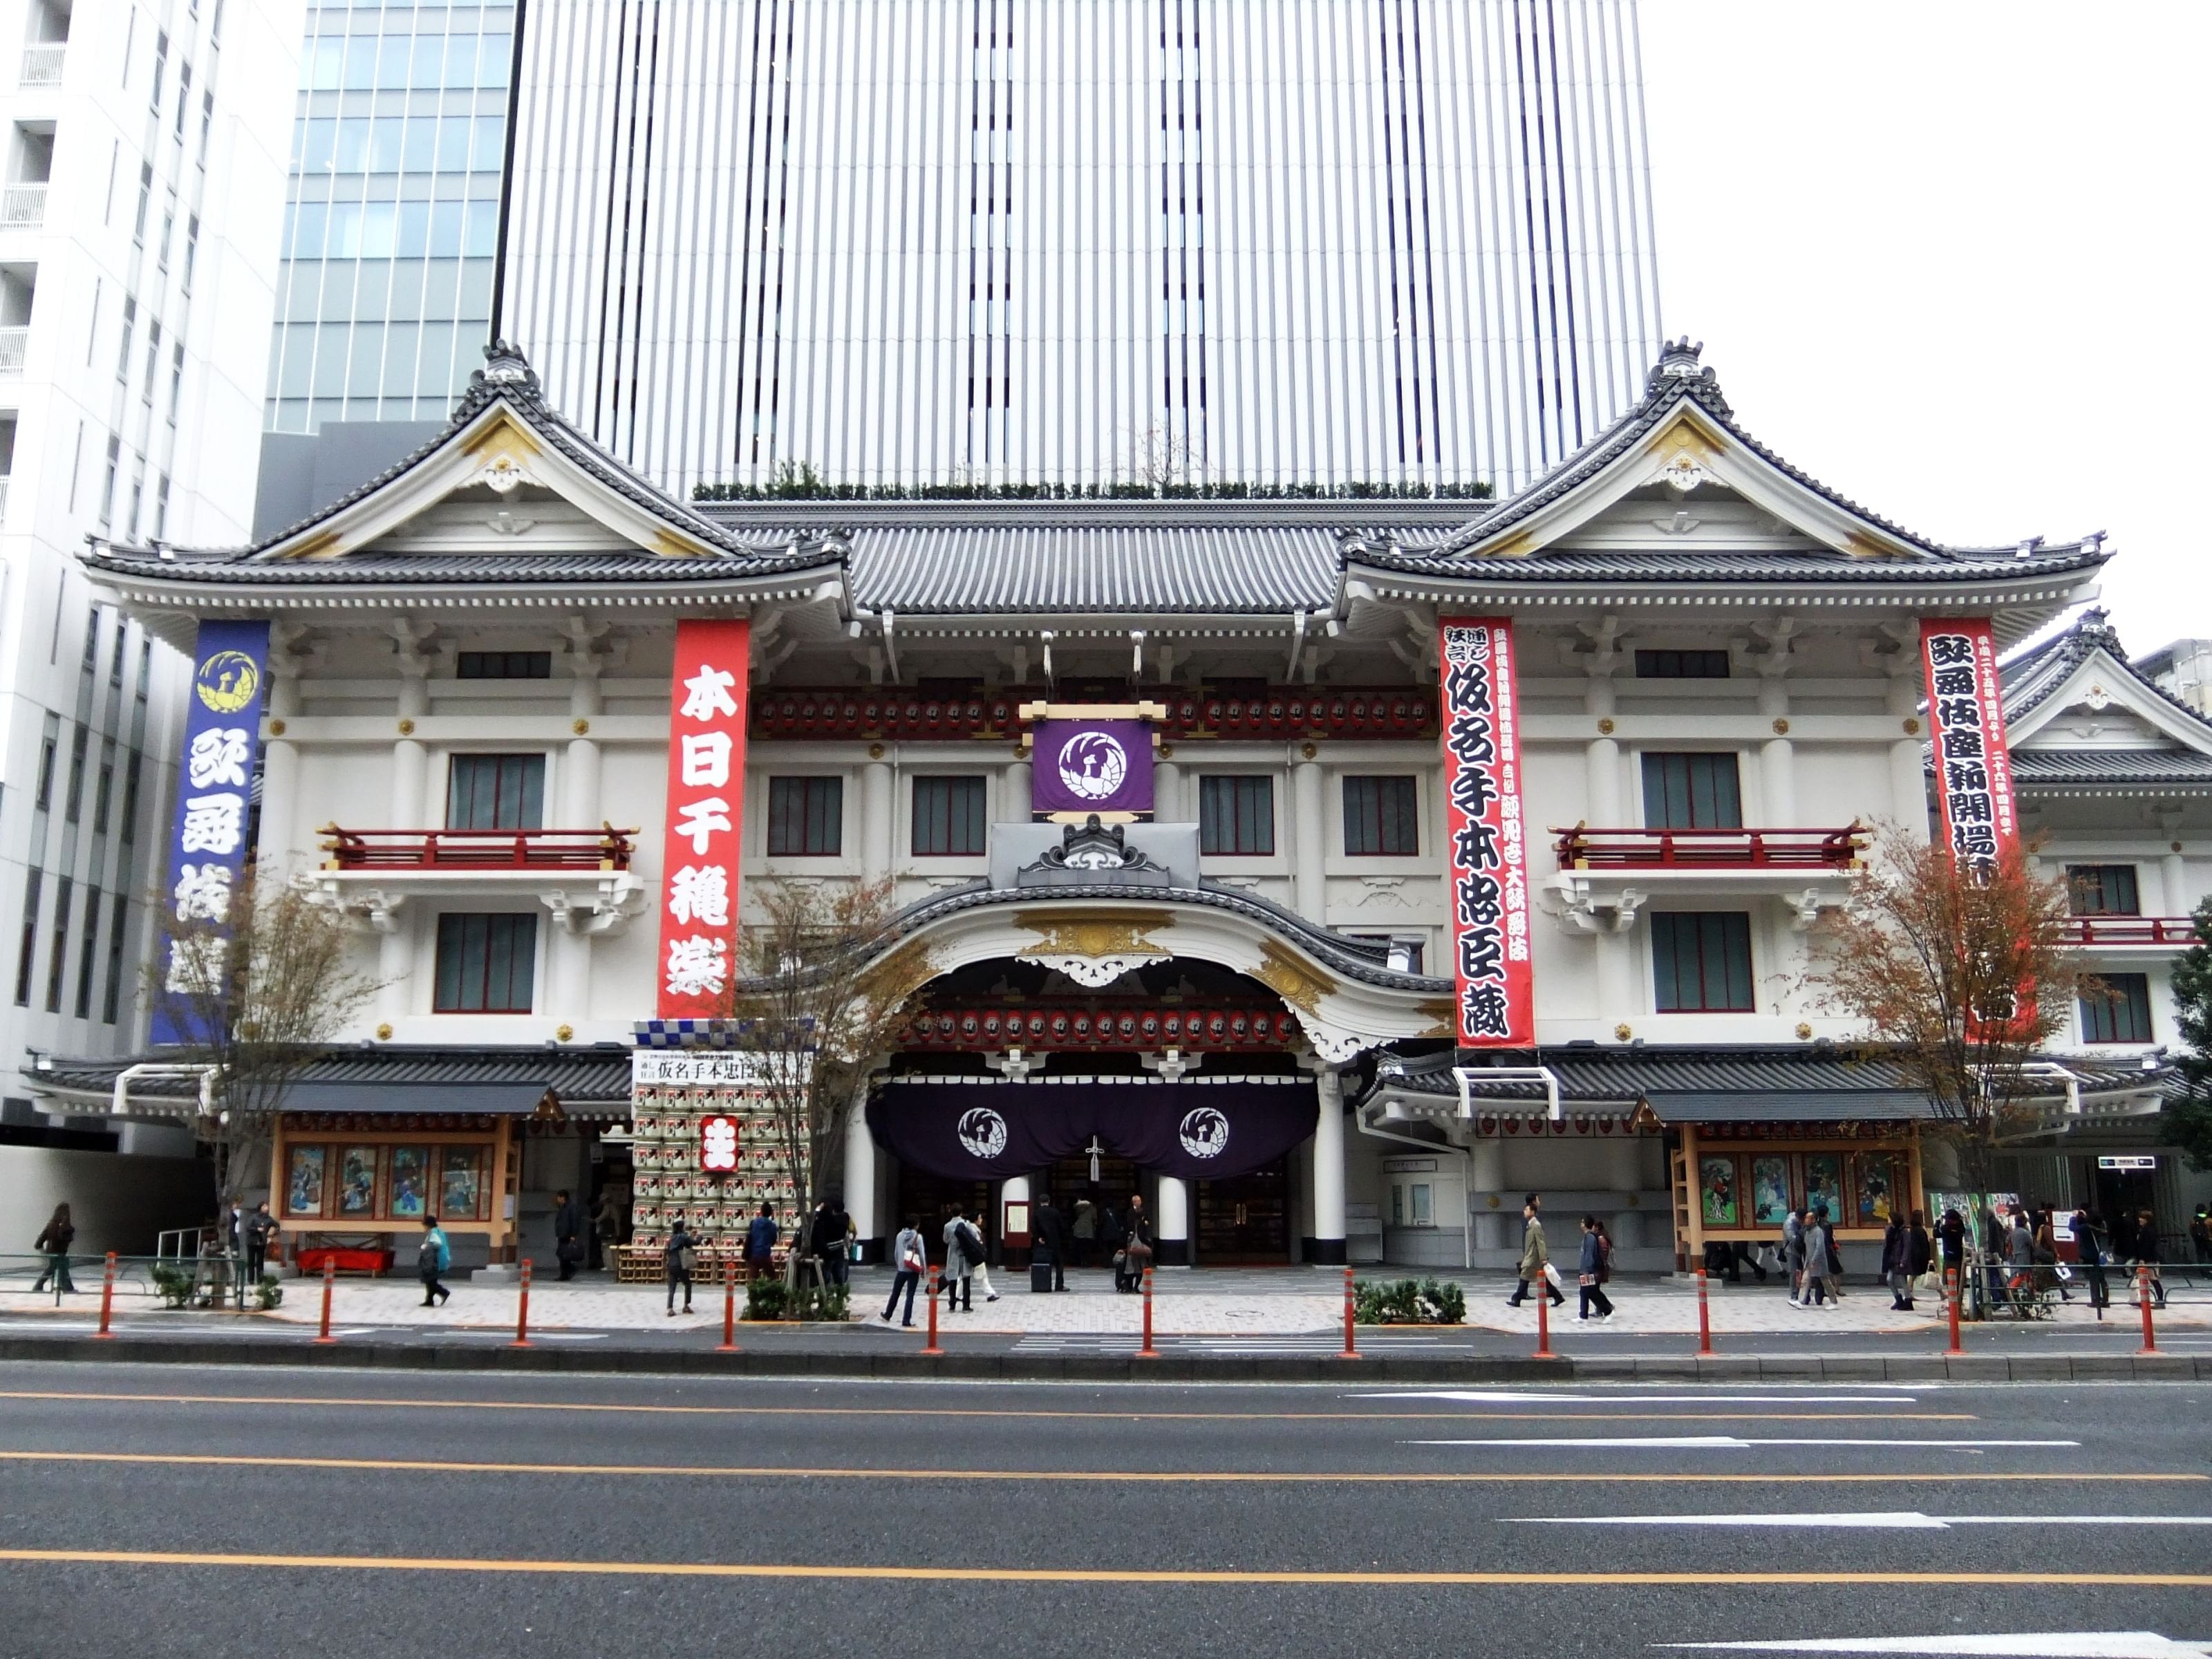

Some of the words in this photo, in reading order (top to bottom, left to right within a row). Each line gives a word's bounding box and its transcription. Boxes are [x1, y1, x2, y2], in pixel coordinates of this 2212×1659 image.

[165, 727, 250, 995] 歌舞伎座
[1445, 662, 1509, 1039] 仮名手本忠臣蔵
[658, 1061, 771, 1080] 仮名手本忠臣
